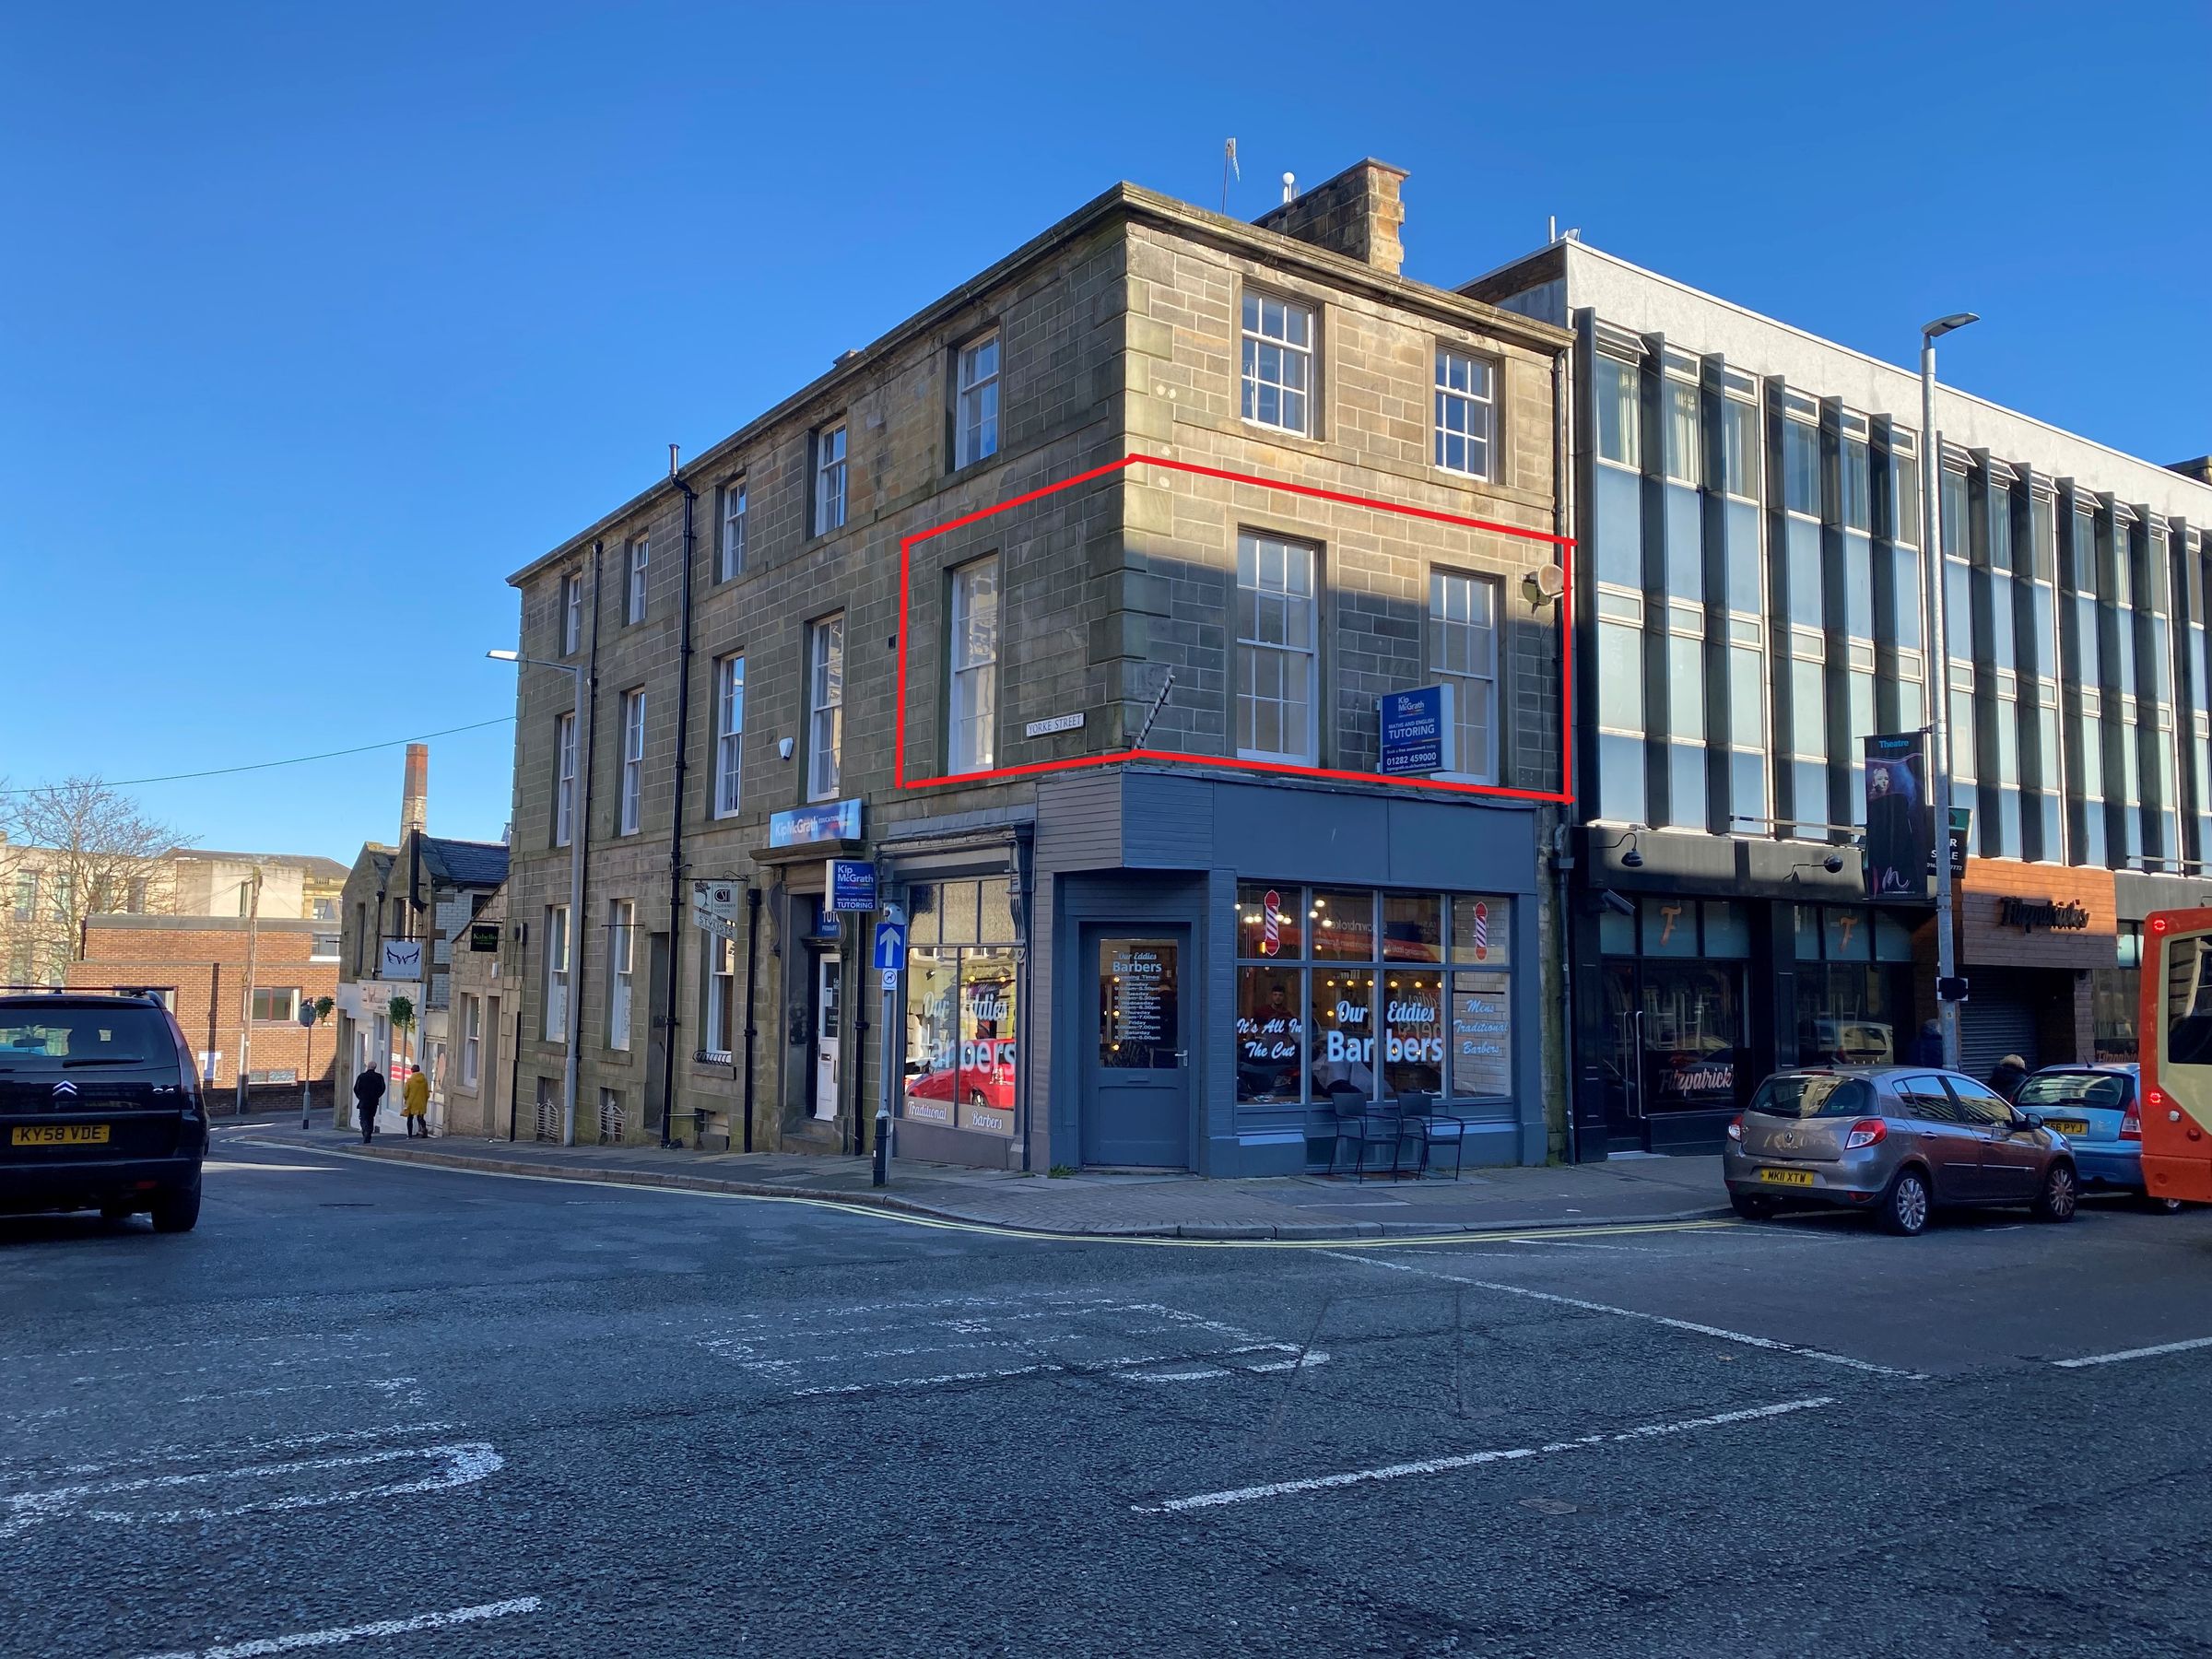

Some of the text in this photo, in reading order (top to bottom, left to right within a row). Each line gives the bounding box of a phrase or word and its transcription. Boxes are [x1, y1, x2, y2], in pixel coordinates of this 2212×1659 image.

[1398, 696, 1409, 705] Kip
[1398, 700, 1425, 712] McGrath
[1028, 715, 1081, 735] YORKE STREET
[1388, 724, 1435, 739] TUTORING
[1878, 740, 1910, 748] Theatre
[1386, 752, 1437, 766] 01282 459000
[837, 865, 853, 875] Kip
[837, 874, 874, 883] McGrath
[699, 915, 734, 935] STYLISTS
[1112, 960, 1161, 972] Barbers
[924, 991, 949, 1018] Our
[1336, 1000, 1435, 1023] Our Eddies
[1466, 999, 1495, 1013] Mens
[1237, 1018, 1302, 1034] It's All In
[1453, 1019, 1509, 1033] Traditional
[1245, 1041, 1296, 1059] The Cut
[1463, 1041, 1500, 1054] Barbers
[907, 1100, 947, 1121] Traditional
[972, 1111, 1003, 1130] Barbers
[20, 1126, 102, 1142] KY58 VDE
[2065, 1123, 2083, 1133] PYJ
[1787, 1172, 1806, 1182] XTW
